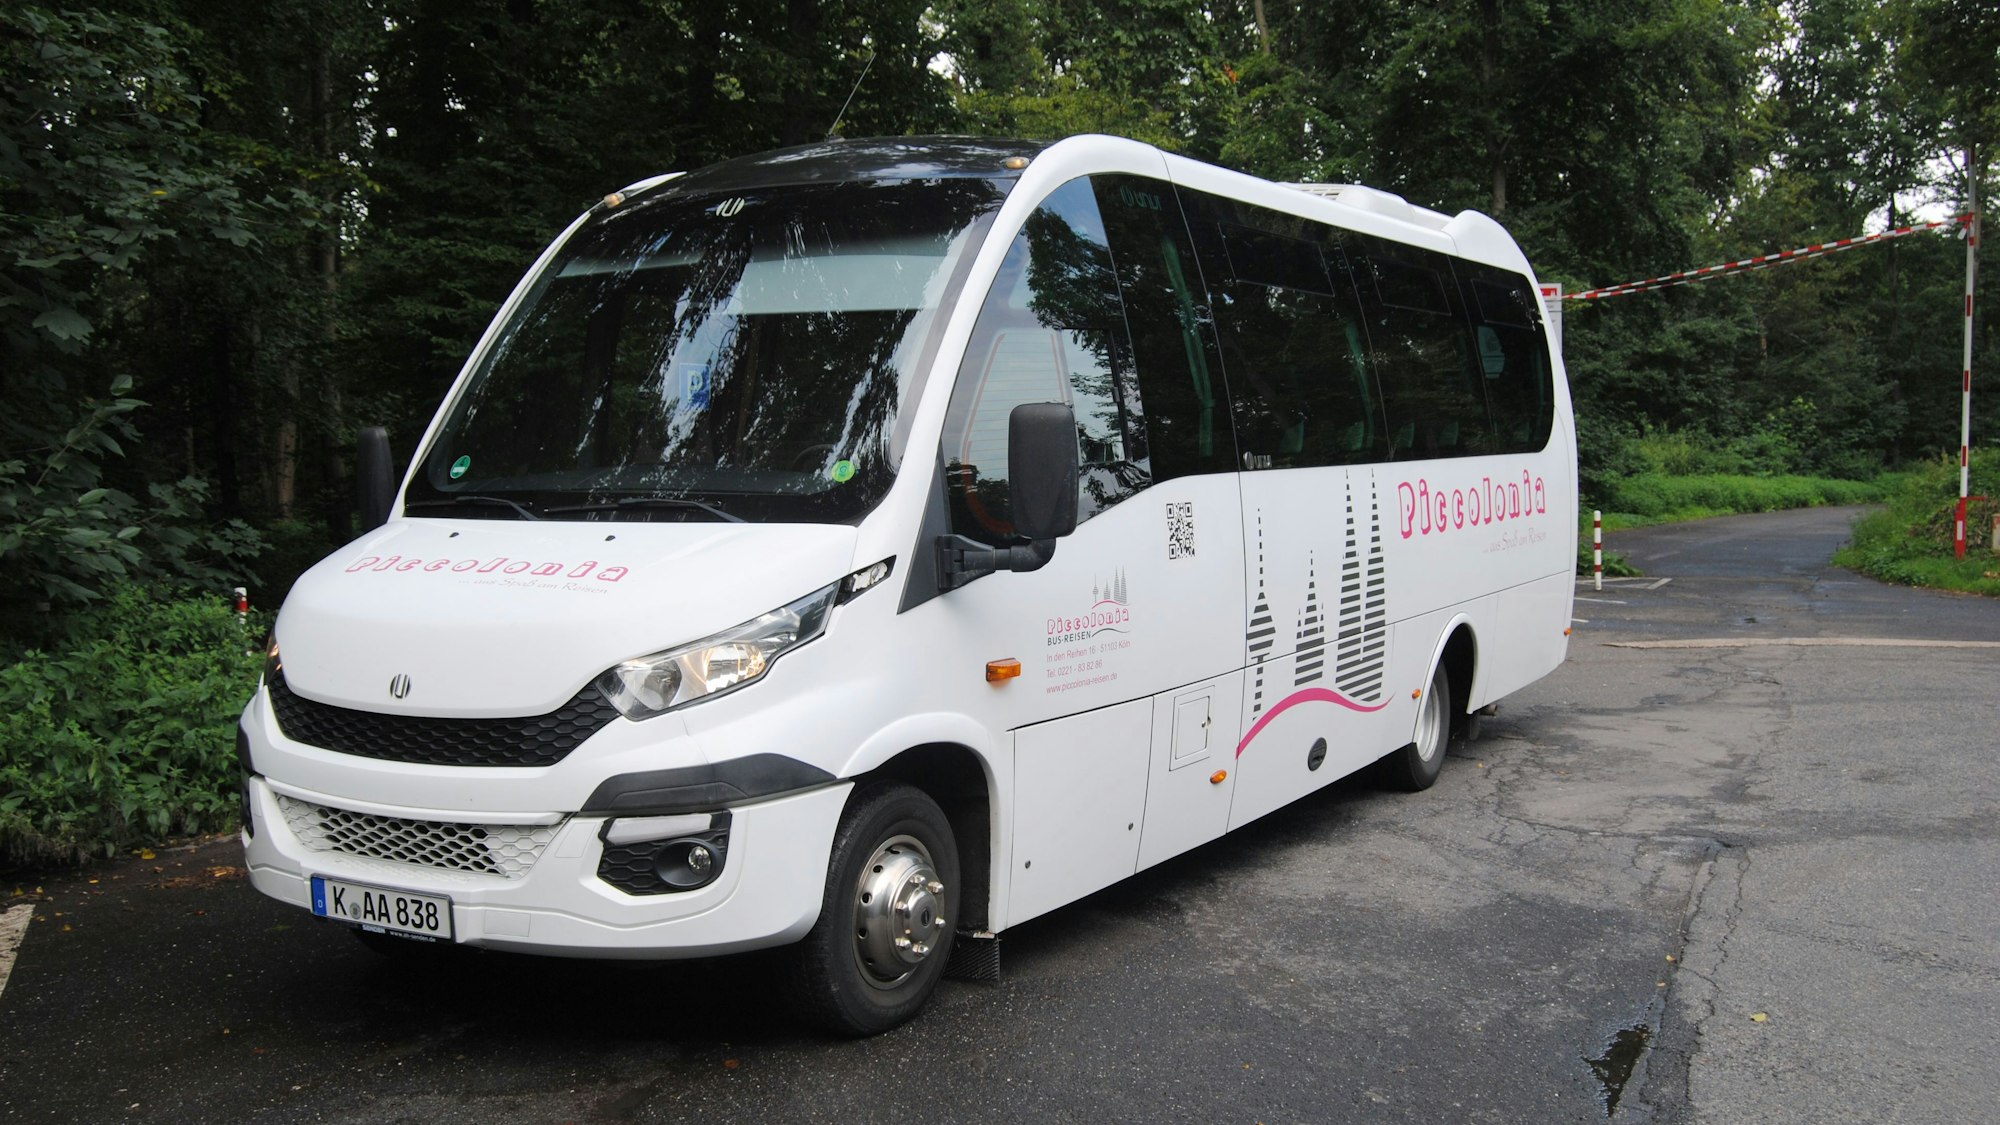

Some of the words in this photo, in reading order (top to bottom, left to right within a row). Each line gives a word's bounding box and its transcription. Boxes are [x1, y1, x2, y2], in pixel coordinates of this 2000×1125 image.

[1398, 469, 1546, 539] Piccolonia
[345, 555, 629, 582] Piccolonia
[498, 577, 538, 588] Spaß
[538, 582, 558, 590] am
[562, 582, 608, 595] Reisen
[1047, 607, 1129, 634] Piccolonia
[1046, 653, 1053, 663] In
[1054, 651, 1066, 662] den
[1089, 645, 1096, 655] 16
[1099, 641, 1118, 653] 51103
[1118, 639, 1131, 650] Köln
[1057, 665, 1073, 677] 0221
[318, 900, 323, 908] D
[333, 885, 347, 915] K
[363, 891, 391, 923] AA
[396, 897, 439, 931] 838
